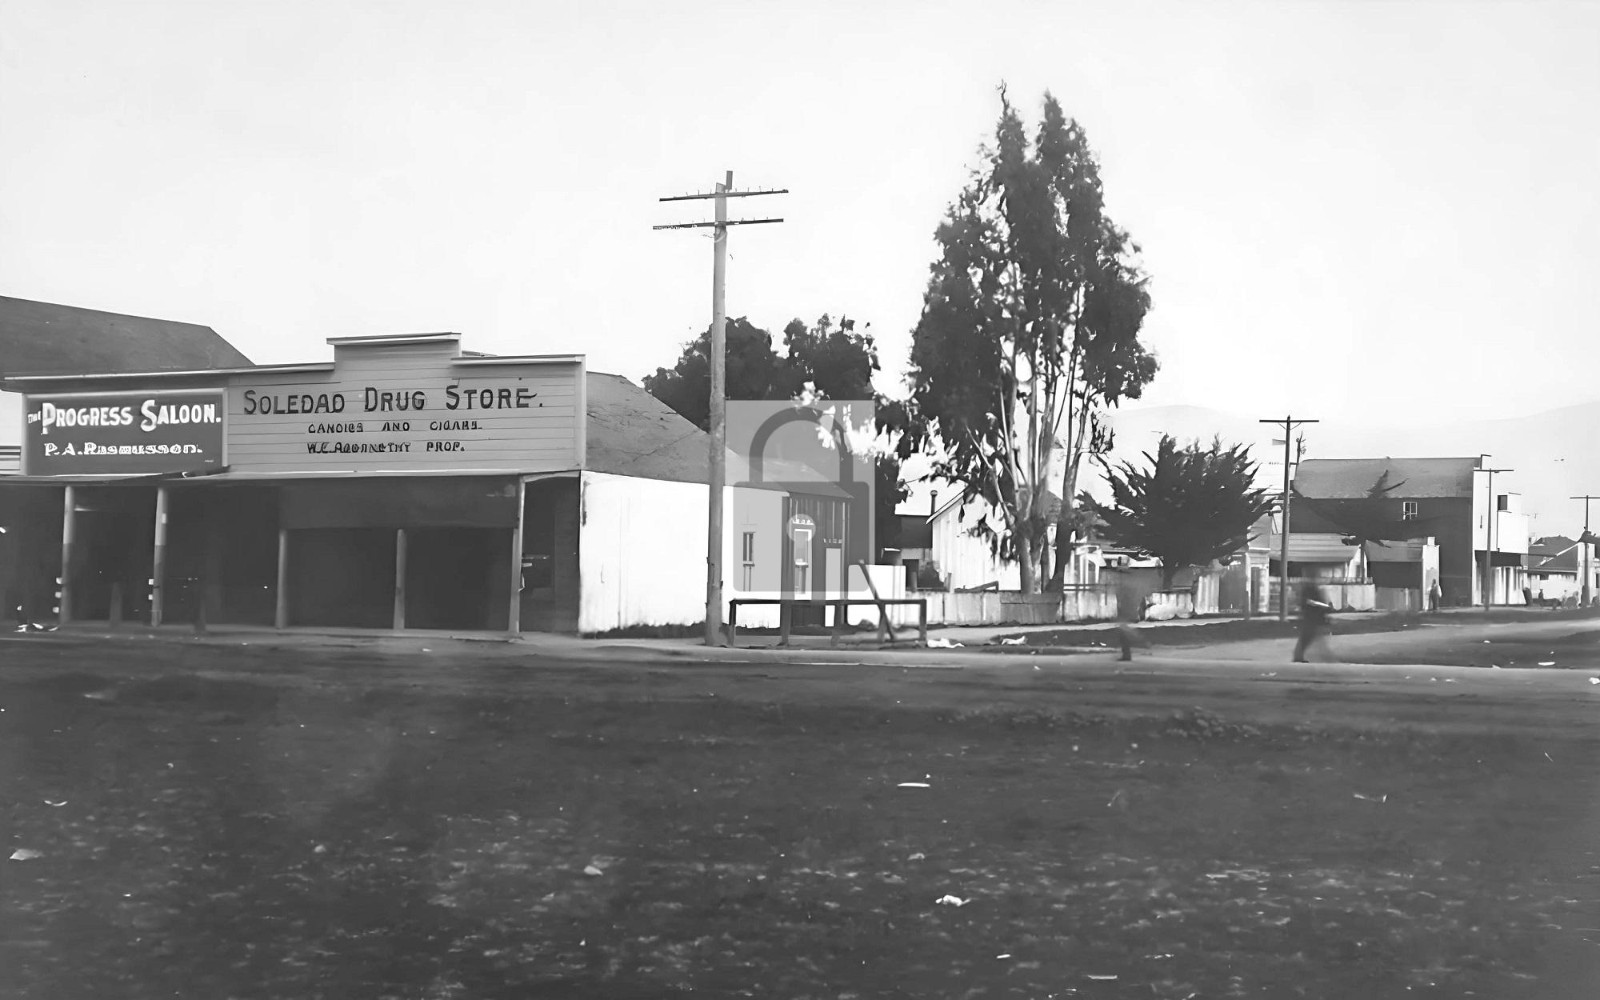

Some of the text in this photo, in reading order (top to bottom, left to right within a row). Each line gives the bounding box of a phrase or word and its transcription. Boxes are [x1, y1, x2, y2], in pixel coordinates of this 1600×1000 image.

[244, 385, 543, 415] SOLEDAD DRUG STORE.
[42, 402, 133, 434] PROGRESS
[141, 400, 221, 431] SALOON.
[382, 421, 410, 432] AND
[426, 441, 465, 452] PROP.
